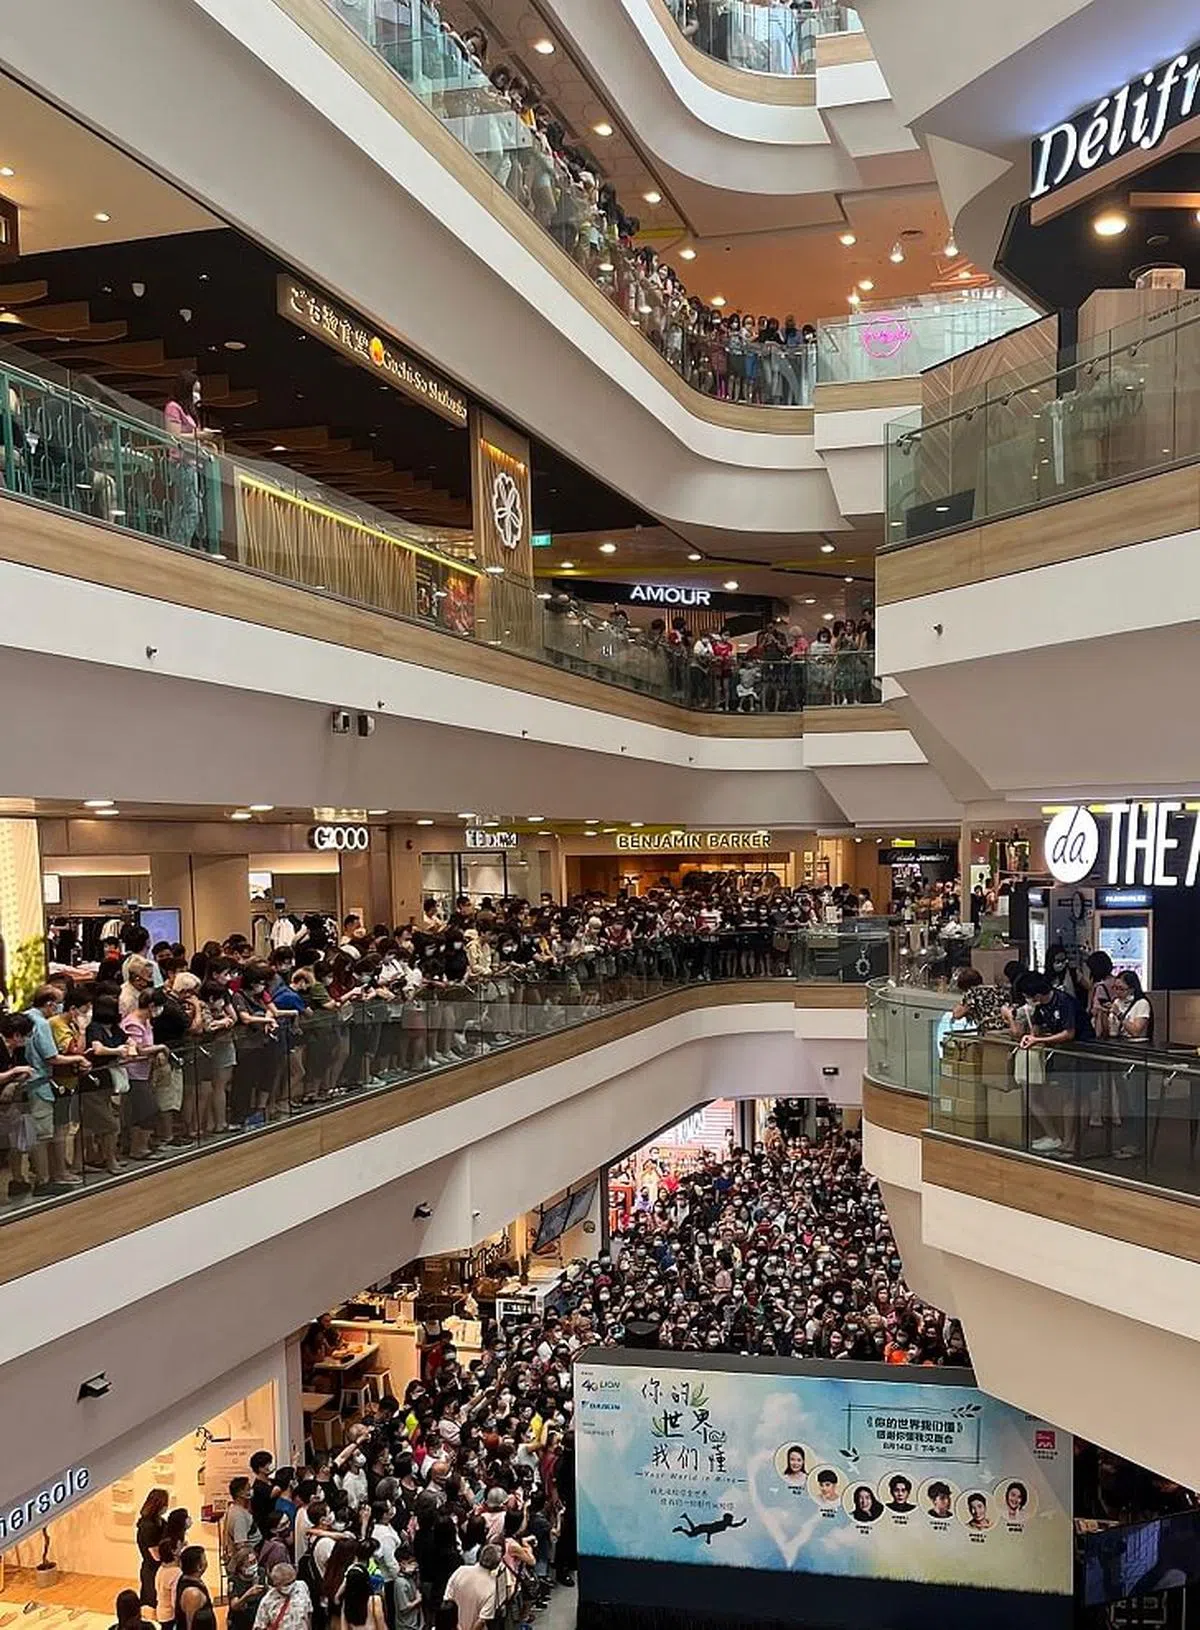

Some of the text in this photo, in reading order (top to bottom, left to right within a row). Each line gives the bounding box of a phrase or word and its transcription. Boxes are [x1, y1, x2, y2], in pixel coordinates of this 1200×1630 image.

[630, 585, 711, 606] AMOUR
[616, 833, 771, 849] BENJAMIN BARKER
[1105, 802, 1181, 886] THE
[642, 1377, 690, 1406] 你的
[662, 1409, 714, 1444] 世界
[652, 1443, 727, 1473] 我们懂
